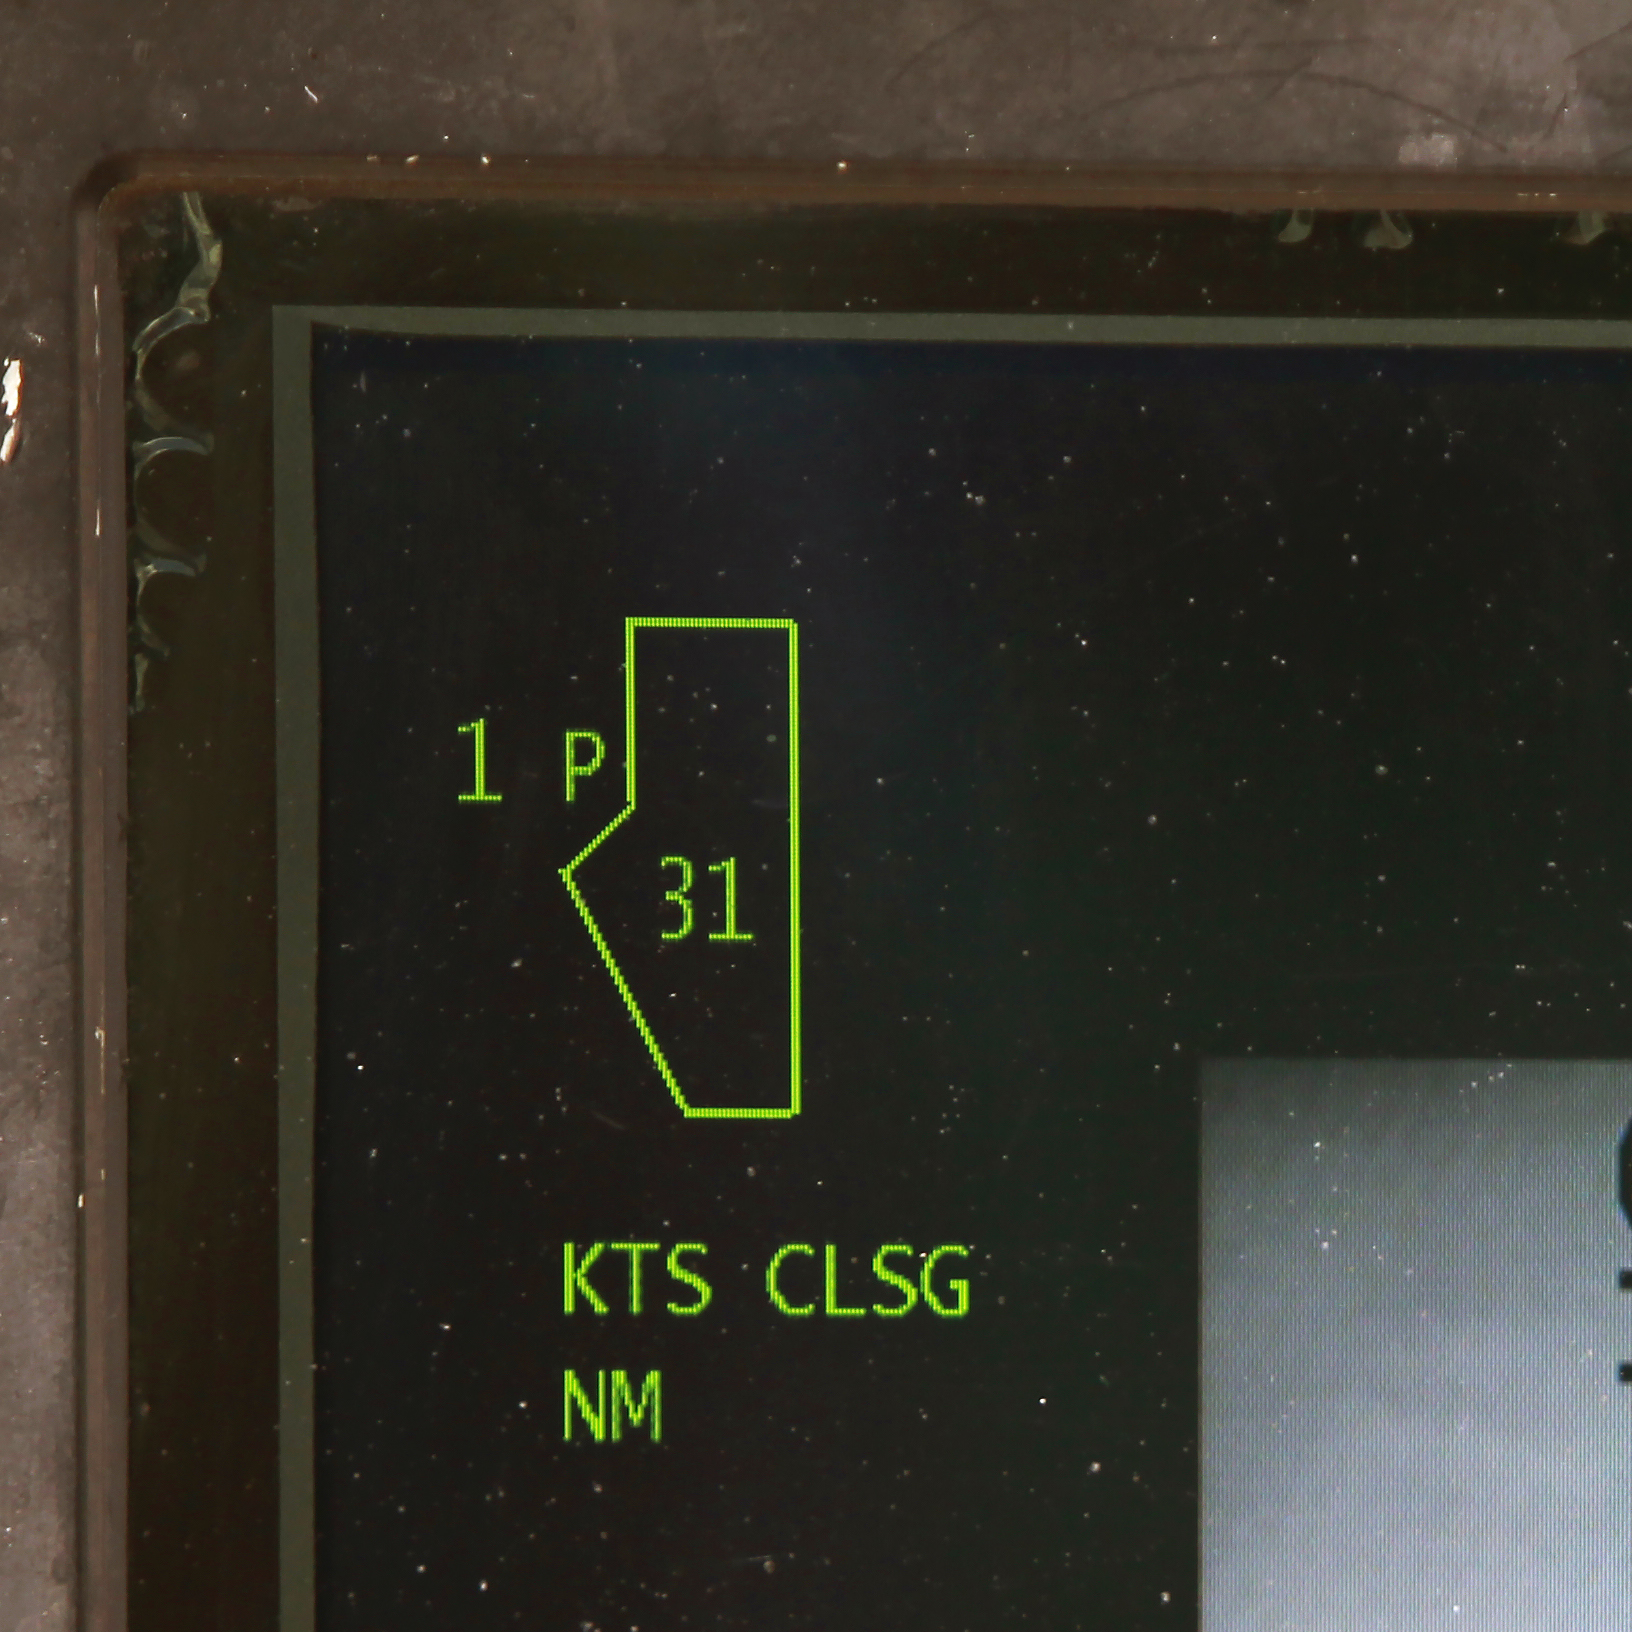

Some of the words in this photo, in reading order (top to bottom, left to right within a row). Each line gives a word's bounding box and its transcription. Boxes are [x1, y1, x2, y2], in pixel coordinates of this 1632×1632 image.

[458, 719, 502, 801] 1
[566, 732, 605, 801] P
[661, 856, 753, 940] 31
[564, 1242, 712, 1315] KTS
[766, 1244, 969, 1317] CLSG
[564, 1370, 661, 1441] NM
